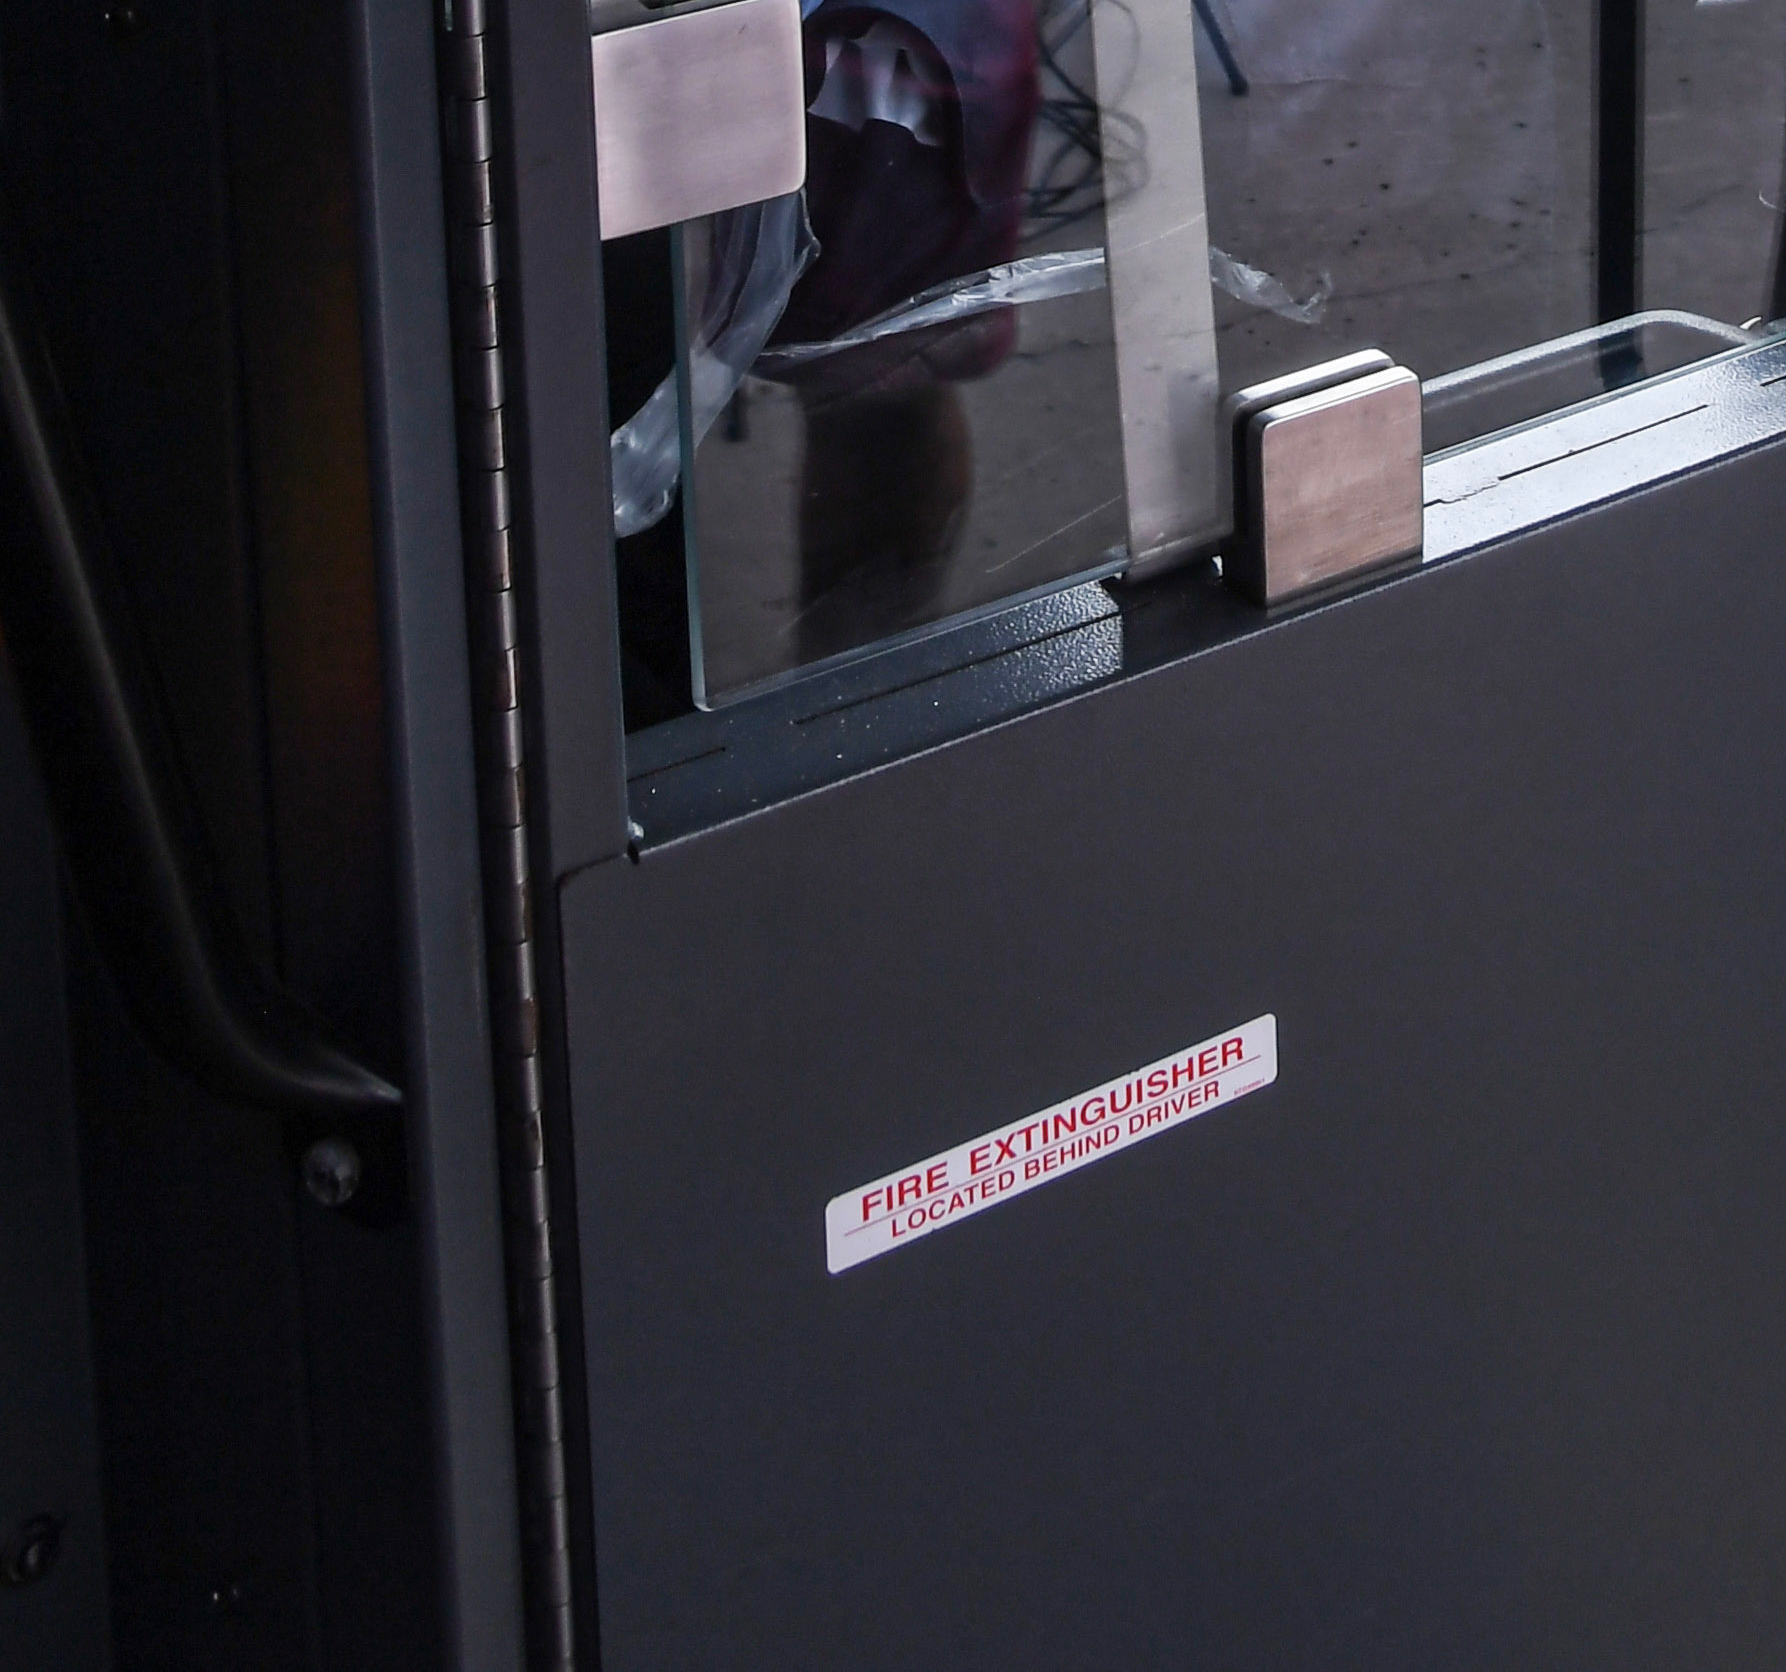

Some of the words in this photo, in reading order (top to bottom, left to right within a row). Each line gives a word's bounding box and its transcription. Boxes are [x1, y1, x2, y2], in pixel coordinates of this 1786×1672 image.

[861, 1161, 950, 1223] FIRE
[969, 1036, 1245, 1176] EXTINGUISHER
[890, 1170, 1016, 1239] LOCATED
[1023, 1123, 1121, 1179] BEHIND
[1128, 1079, 1221, 1137] DRIVER
